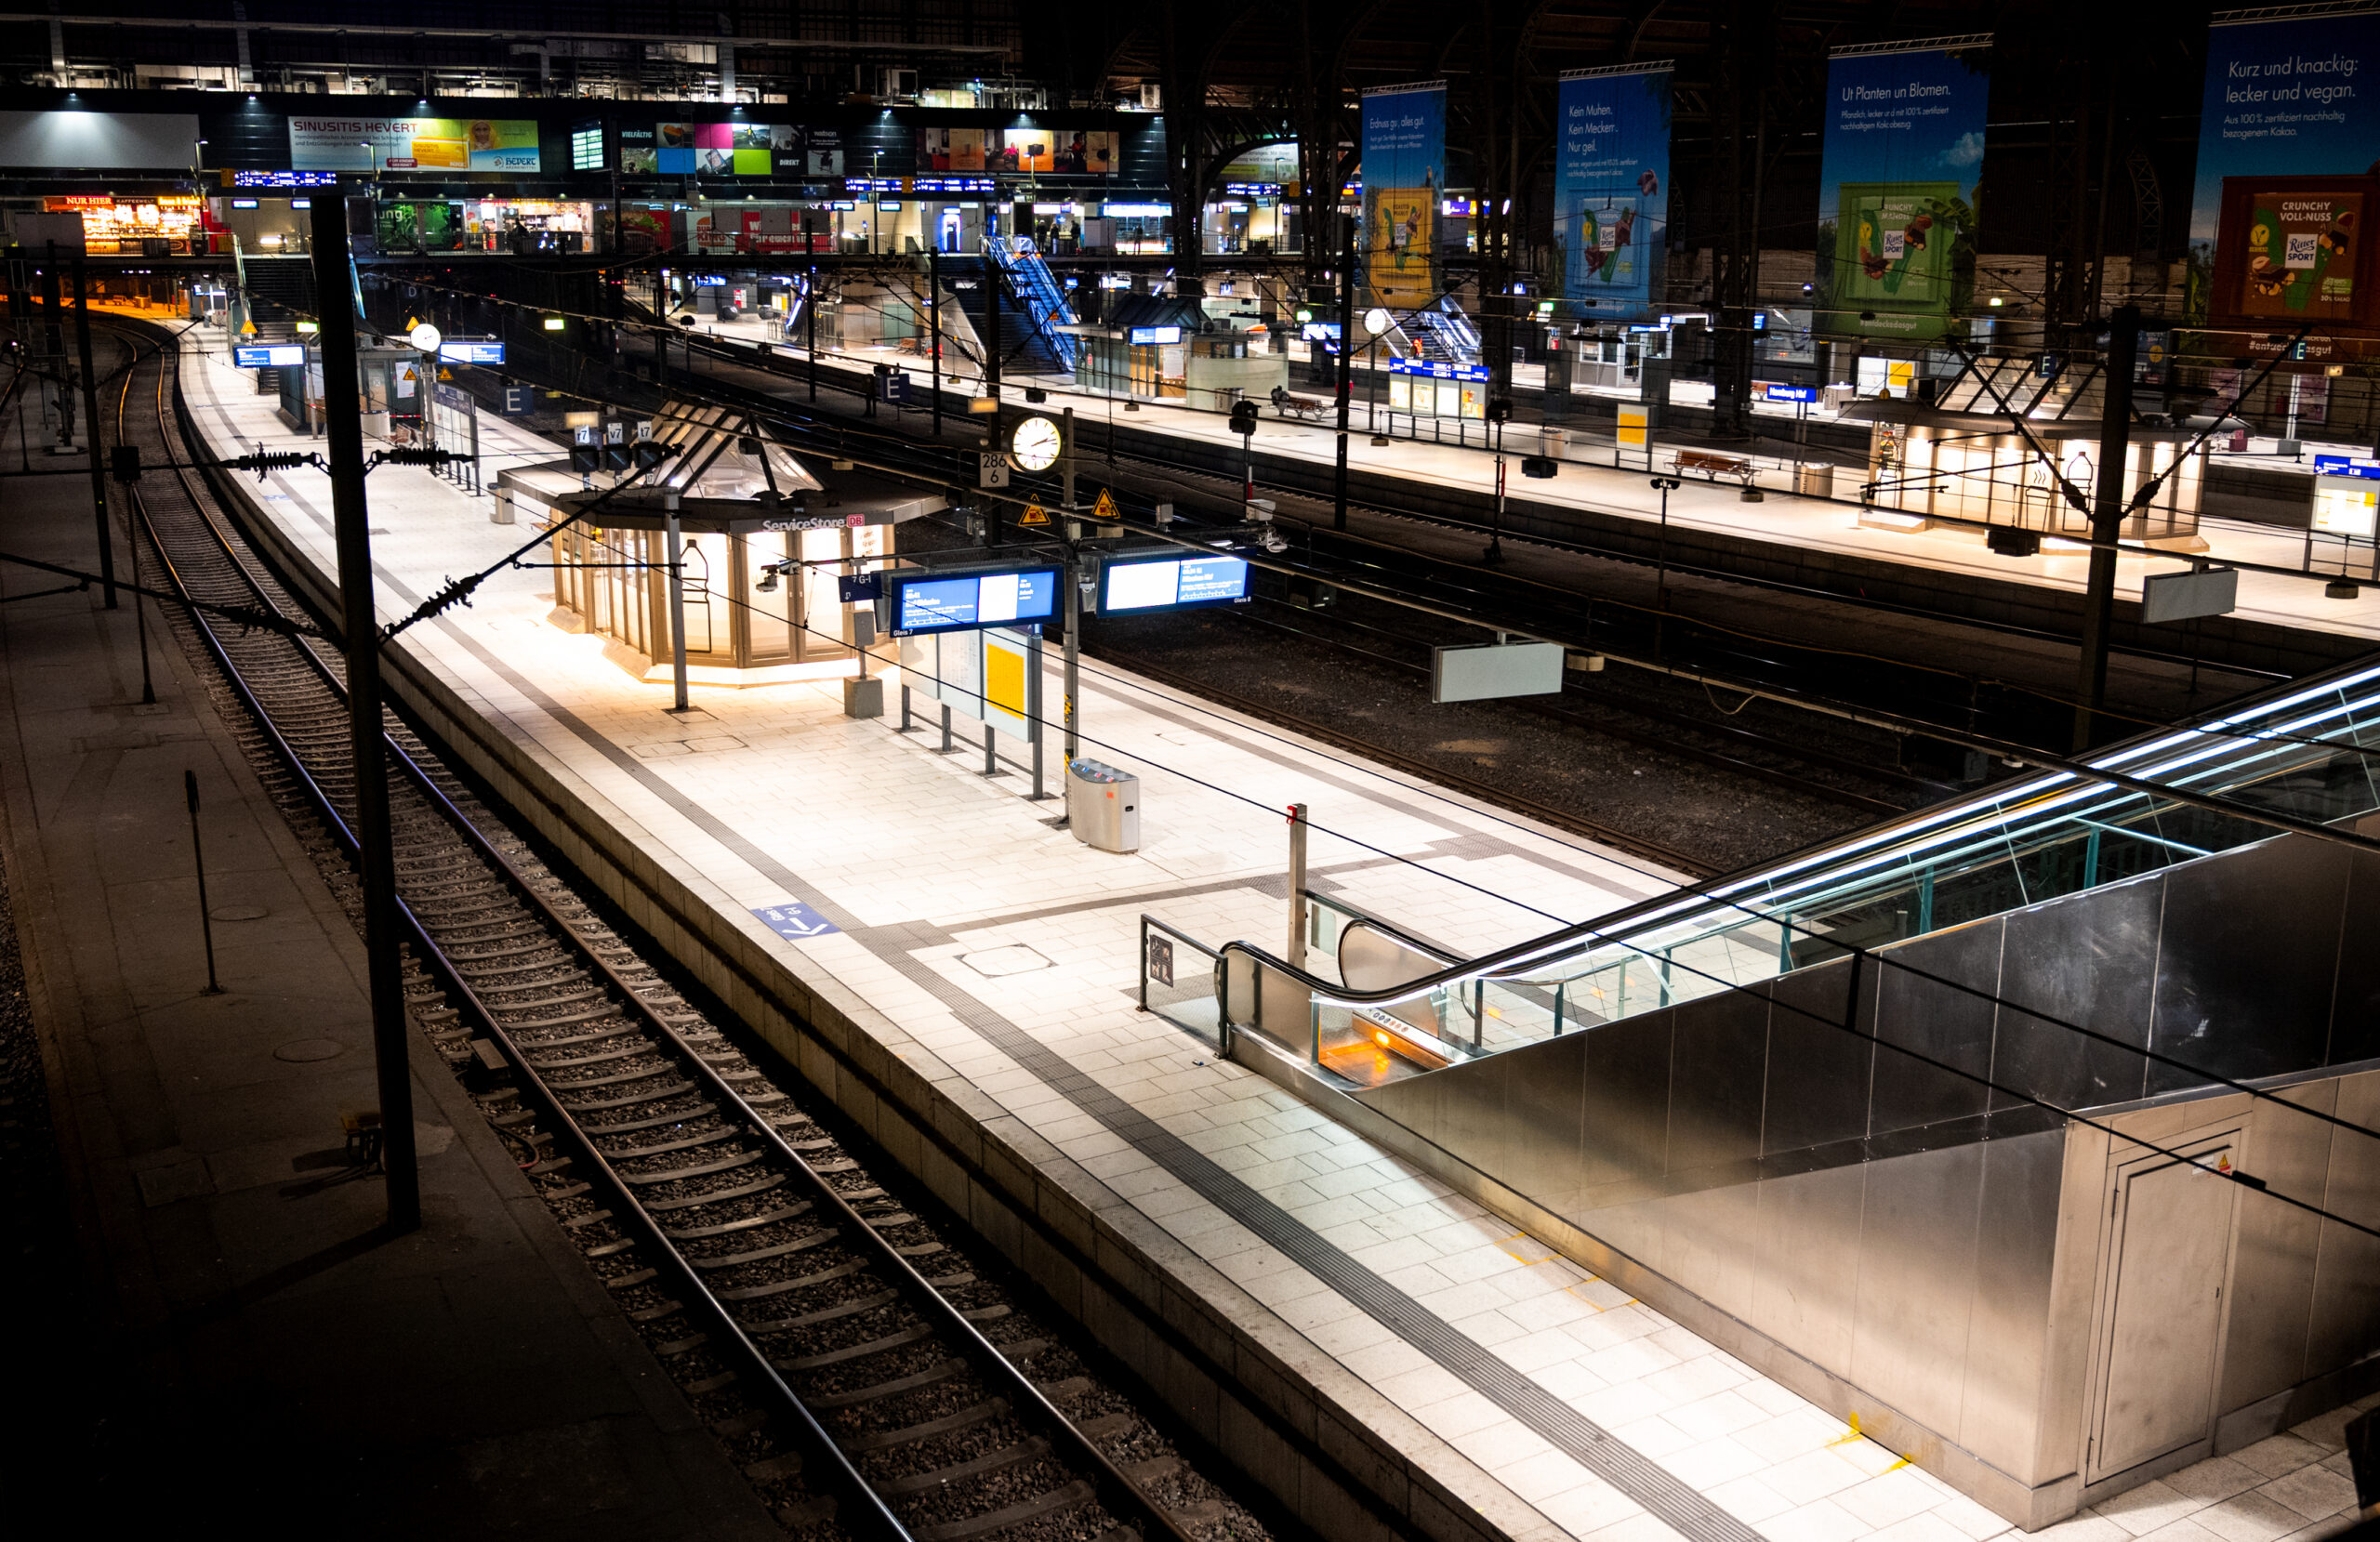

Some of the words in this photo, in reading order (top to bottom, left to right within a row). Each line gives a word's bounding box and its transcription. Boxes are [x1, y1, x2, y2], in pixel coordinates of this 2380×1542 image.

[2228, 60, 2260, 78] Kurz
[2264, 56, 2293, 76] und
[2295, 53, 2359, 77] knackig:
[1842, 87, 1853, 101] Ut
[1856, 85, 1891, 100] Planten
[1894, 88, 1907, 99] un
[1909, 82, 1951, 98] Blomen.
[2226, 84, 2268, 103] lecker
[2272, 81, 2301, 101] und
[2305, 85, 2356, 104] vegan.
[1568, 105, 1584, 117] Kein
[1585, 102, 1613, 116] Muhen.
[2224, 114, 2239, 125] Aus
[2264, 111, 2302, 124] zertifiziert
[2303, 110, 2346, 124] nachhaltig
[294, 120, 363, 133] SINUSITIS
[364, 122, 418, 133] HEVERT
[621, 129, 653, 138] VIELFÄLTIG
[1567, 123, 1583, 135] Kein
[2223, 127, 2268, 140] bezogenem
[2269, 126, 2298, 138] Kakao.
[1567, 140, 1582, 152] Nur
[1582, 138, 1597, 155] geil.
[2281, 202, 2332, 211] CRUNCHY
[2279, 212, 2332, 221] VOLL-NUSS
[2288, 238, 2316, 252] Ritter
[2287, 252, 2315, 261] SPORT
[408, 286, 417, 297] D
[1223, 283, 1232, 294] D
[2297, 342, 2306, 360] E
[2041, 355, 2051, 375] E
[887, 376, 900, 399] E
[1795, 389, 1806, 399] Hbf
[506, 389, 522, 412] E
[610, 428, 621, 439] v7
[640, 427, 650, 438] t7
[982, 454, 1007, 468] 286
[989, 469, 999, 483] 6
[762, 517, 845, 532] ServiceStore
[850, 517, 863, 525] DB
